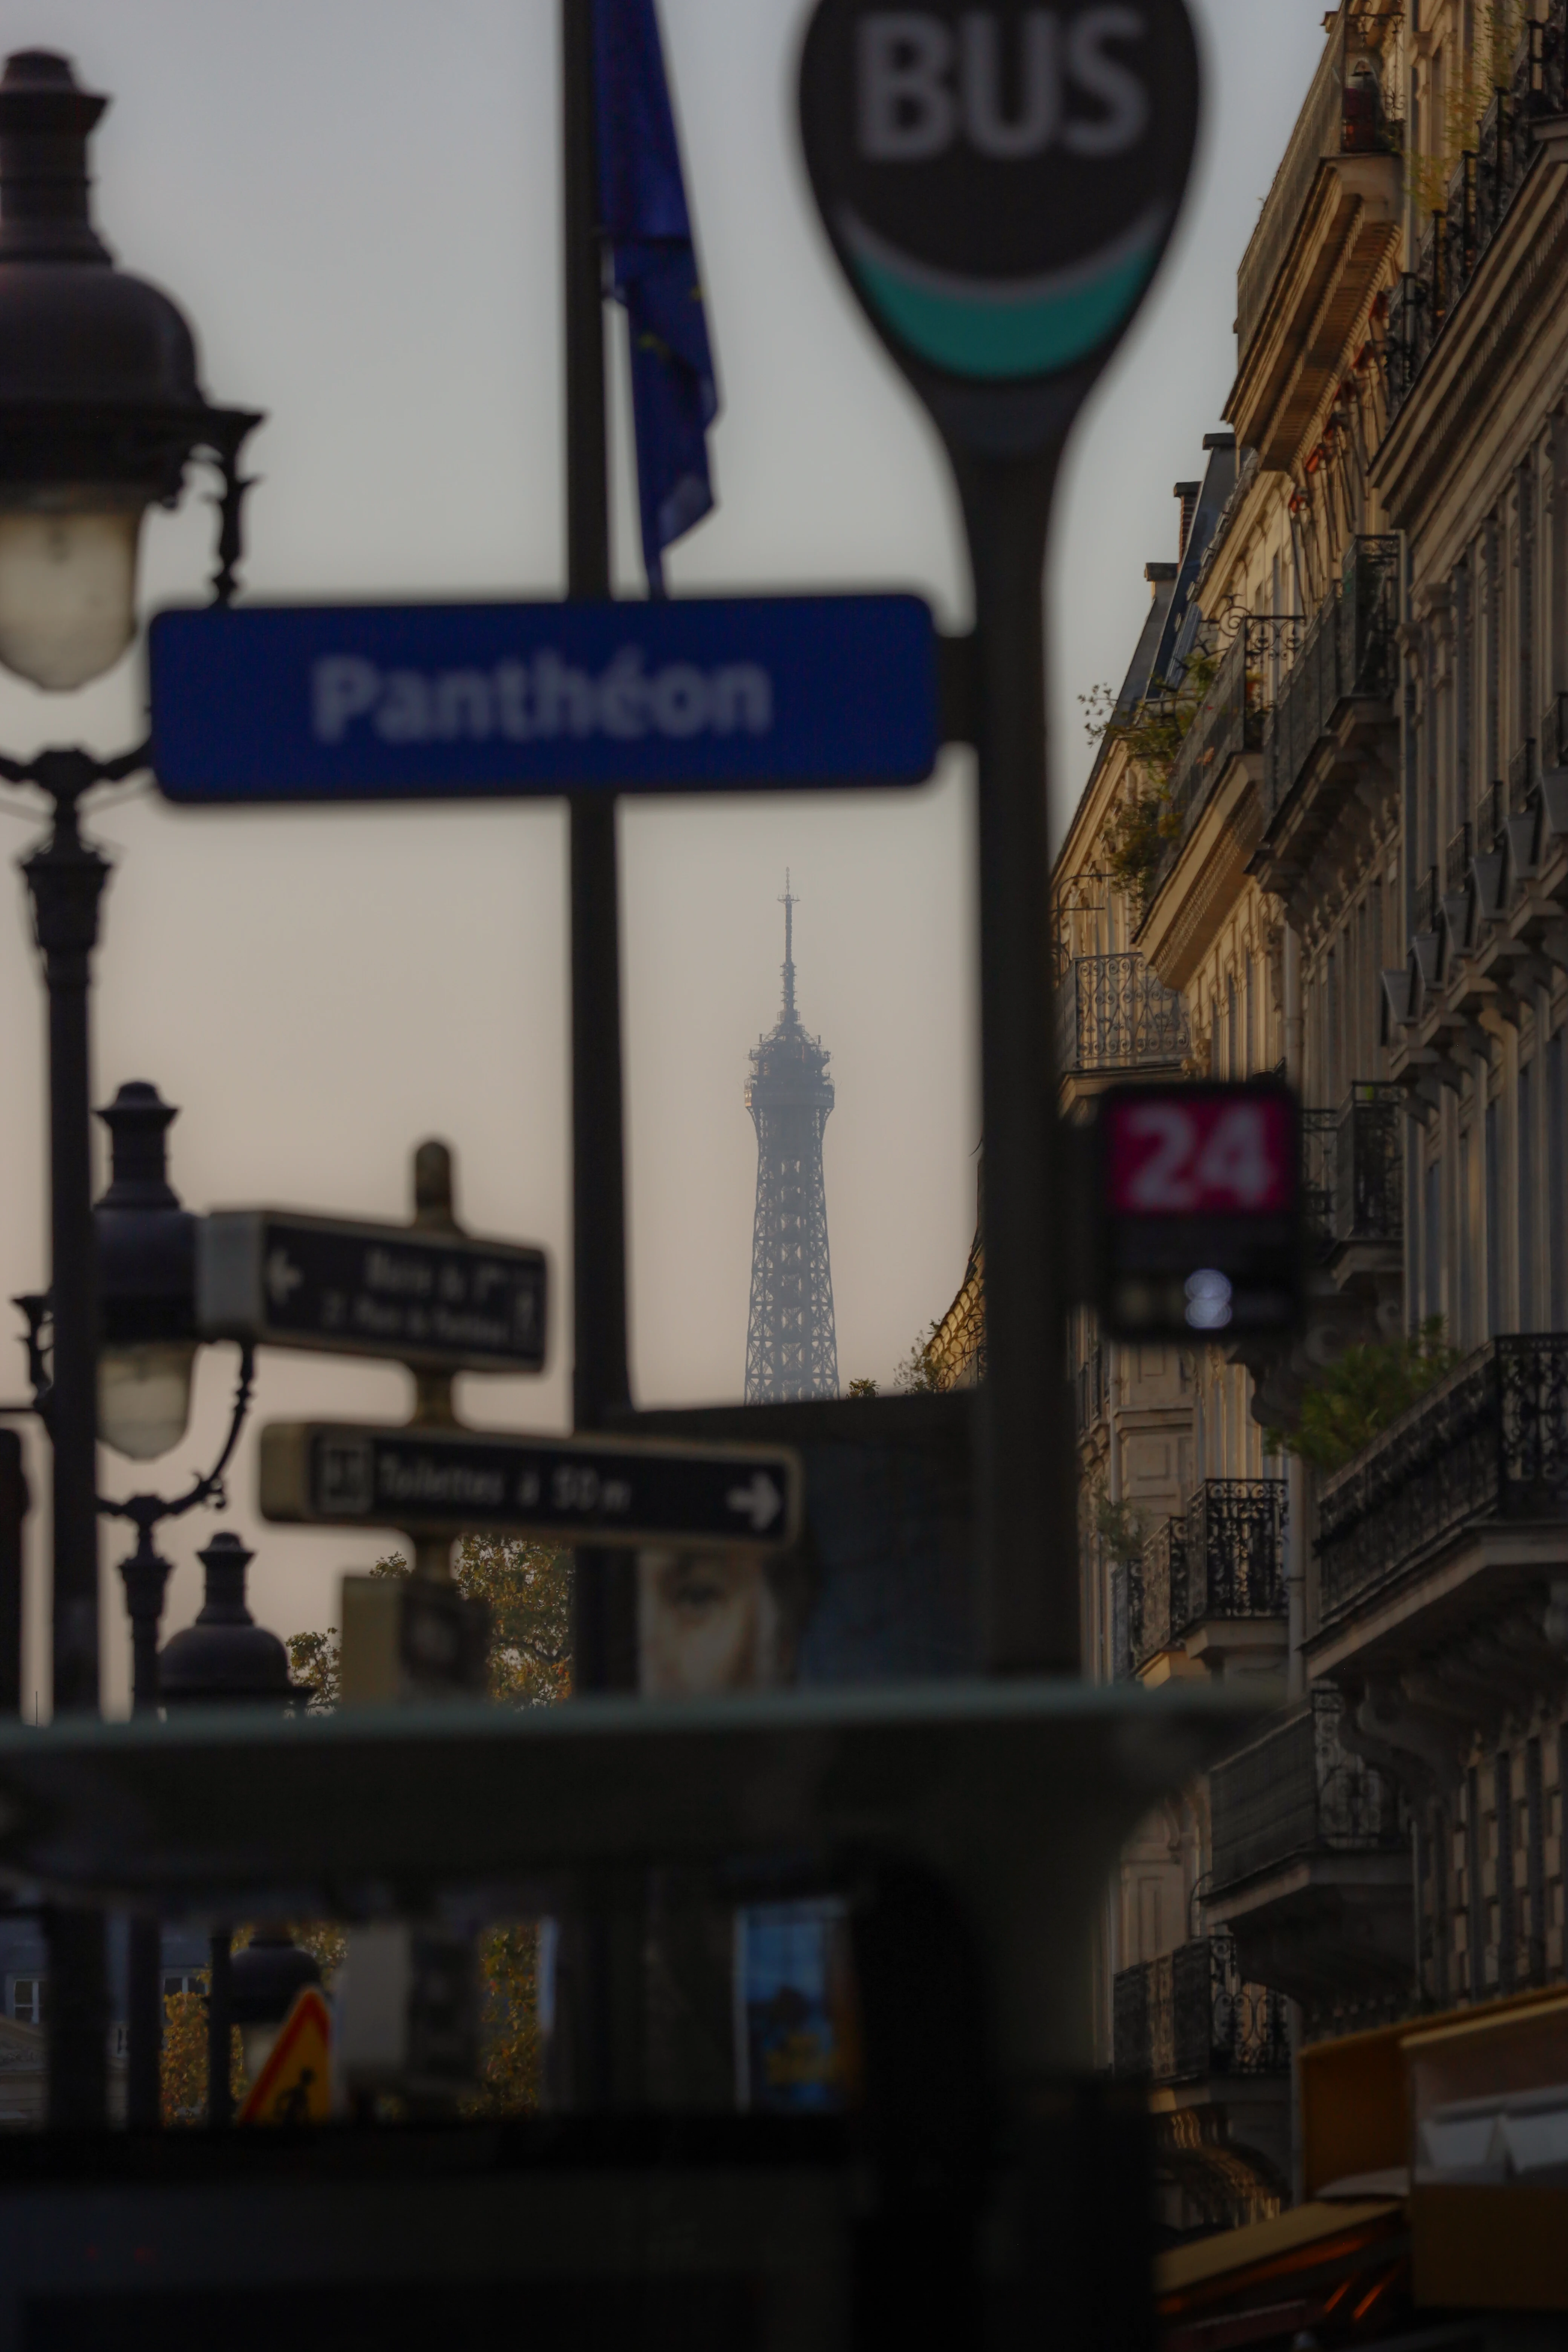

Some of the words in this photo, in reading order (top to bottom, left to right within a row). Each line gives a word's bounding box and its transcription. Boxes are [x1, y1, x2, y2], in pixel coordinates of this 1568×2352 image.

[857, 7, 1148, 161] BUS
[312, 648, 773, 745] Panthéon
[1125, 1101, 1275, 1209] 24
